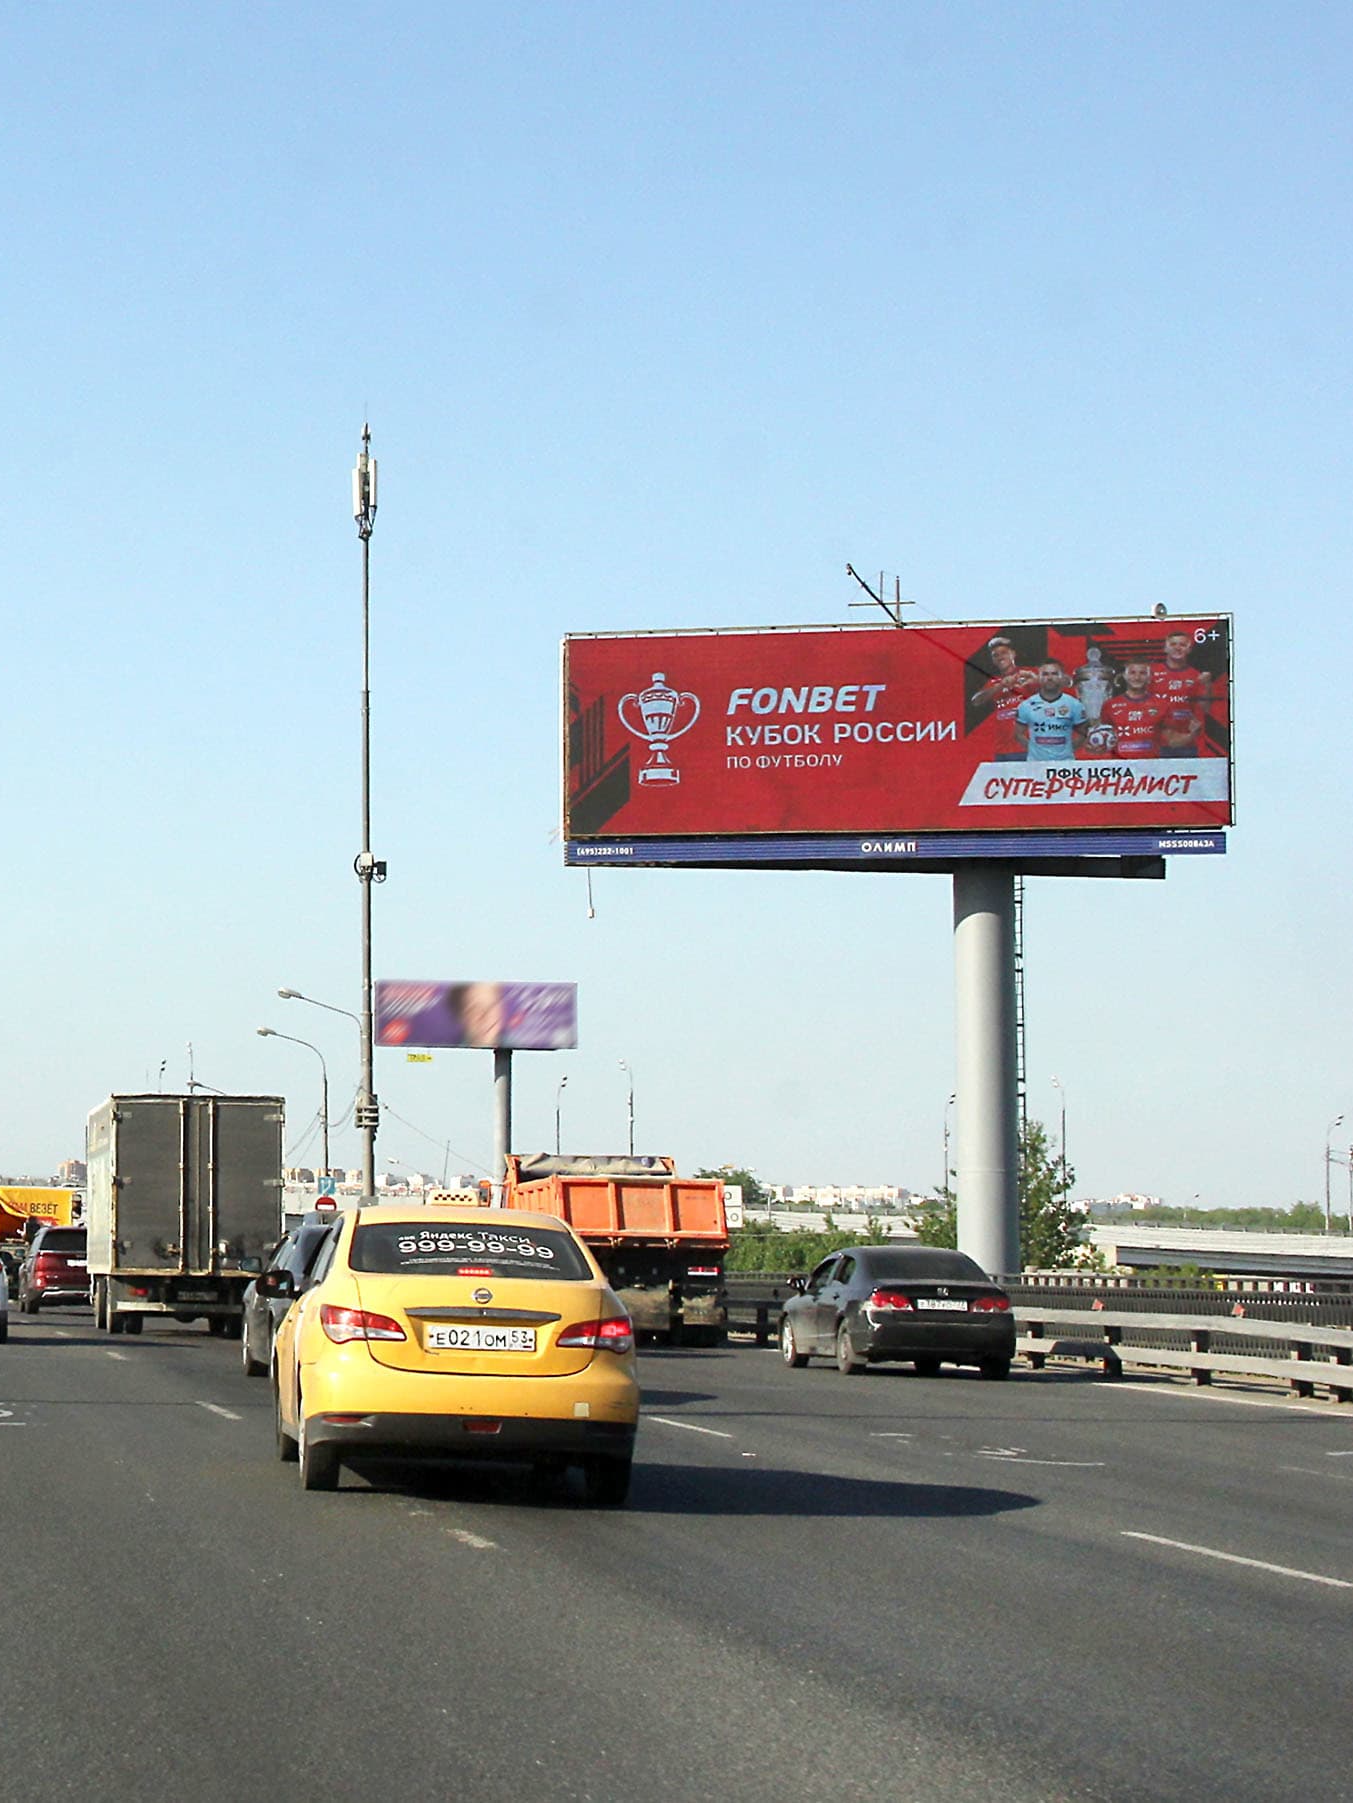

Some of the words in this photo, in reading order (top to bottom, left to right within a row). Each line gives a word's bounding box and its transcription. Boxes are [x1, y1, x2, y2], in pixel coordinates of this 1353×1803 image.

[1194, 628, 1221, 644] 6+
[726, 684, 886, 715] FONBET
[726, 723, 822, 746] КУБОК
[833, 720, 957, 744] РОССИИ
[726, 755, 751, 769] ПО
[755, 754, 843, 769] ФУТБОЛУ
[1046, 767, 1082, 780] ПФК
[1088, 766, 1135, 780] ЦСКА
[984, 774, 1198, 799] СУПЕРФИНАЛИСТ
[861, 841, 916, 853] ОЛИМП
[419, 1231, 474, 1241] Яндекс
[477, 1231, 531, 1245] Такси
[398, 1240, 554, 1260] 999-99-99
